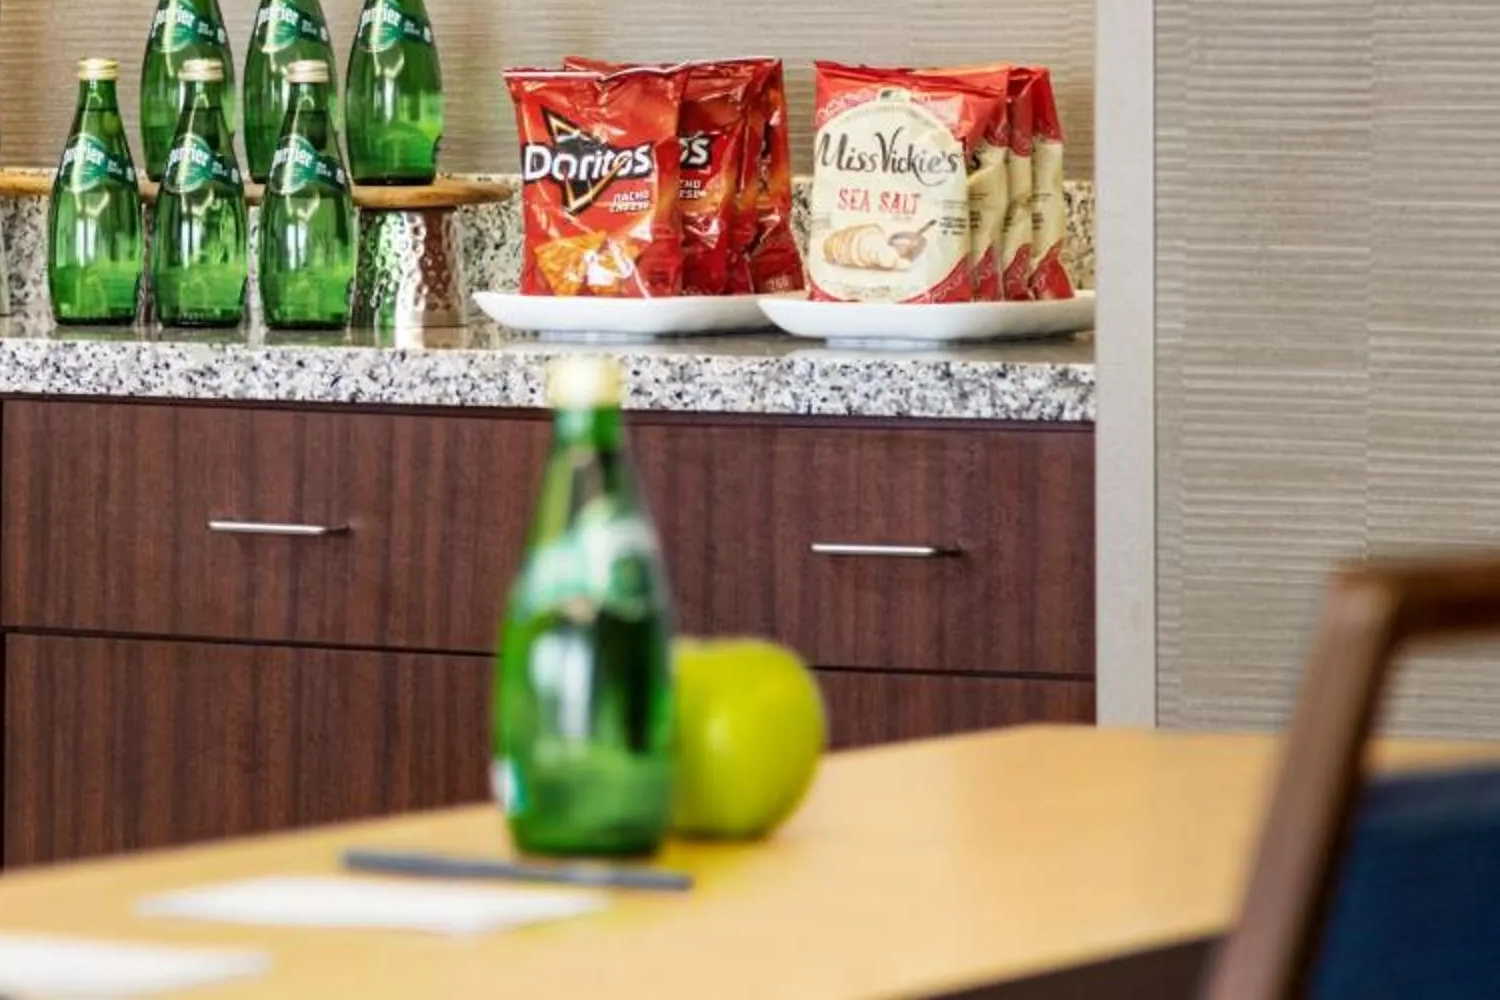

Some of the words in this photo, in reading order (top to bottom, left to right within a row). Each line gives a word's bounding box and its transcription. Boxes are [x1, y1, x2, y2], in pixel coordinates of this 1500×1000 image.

[525, 144, 650, 181] Doritos
[817, 132, 878, 173] Miss
[875, 126, 958, 186] Vickie's
[838, 187, 870, 213] SEA
[879, 191, 921, 214] SALT
